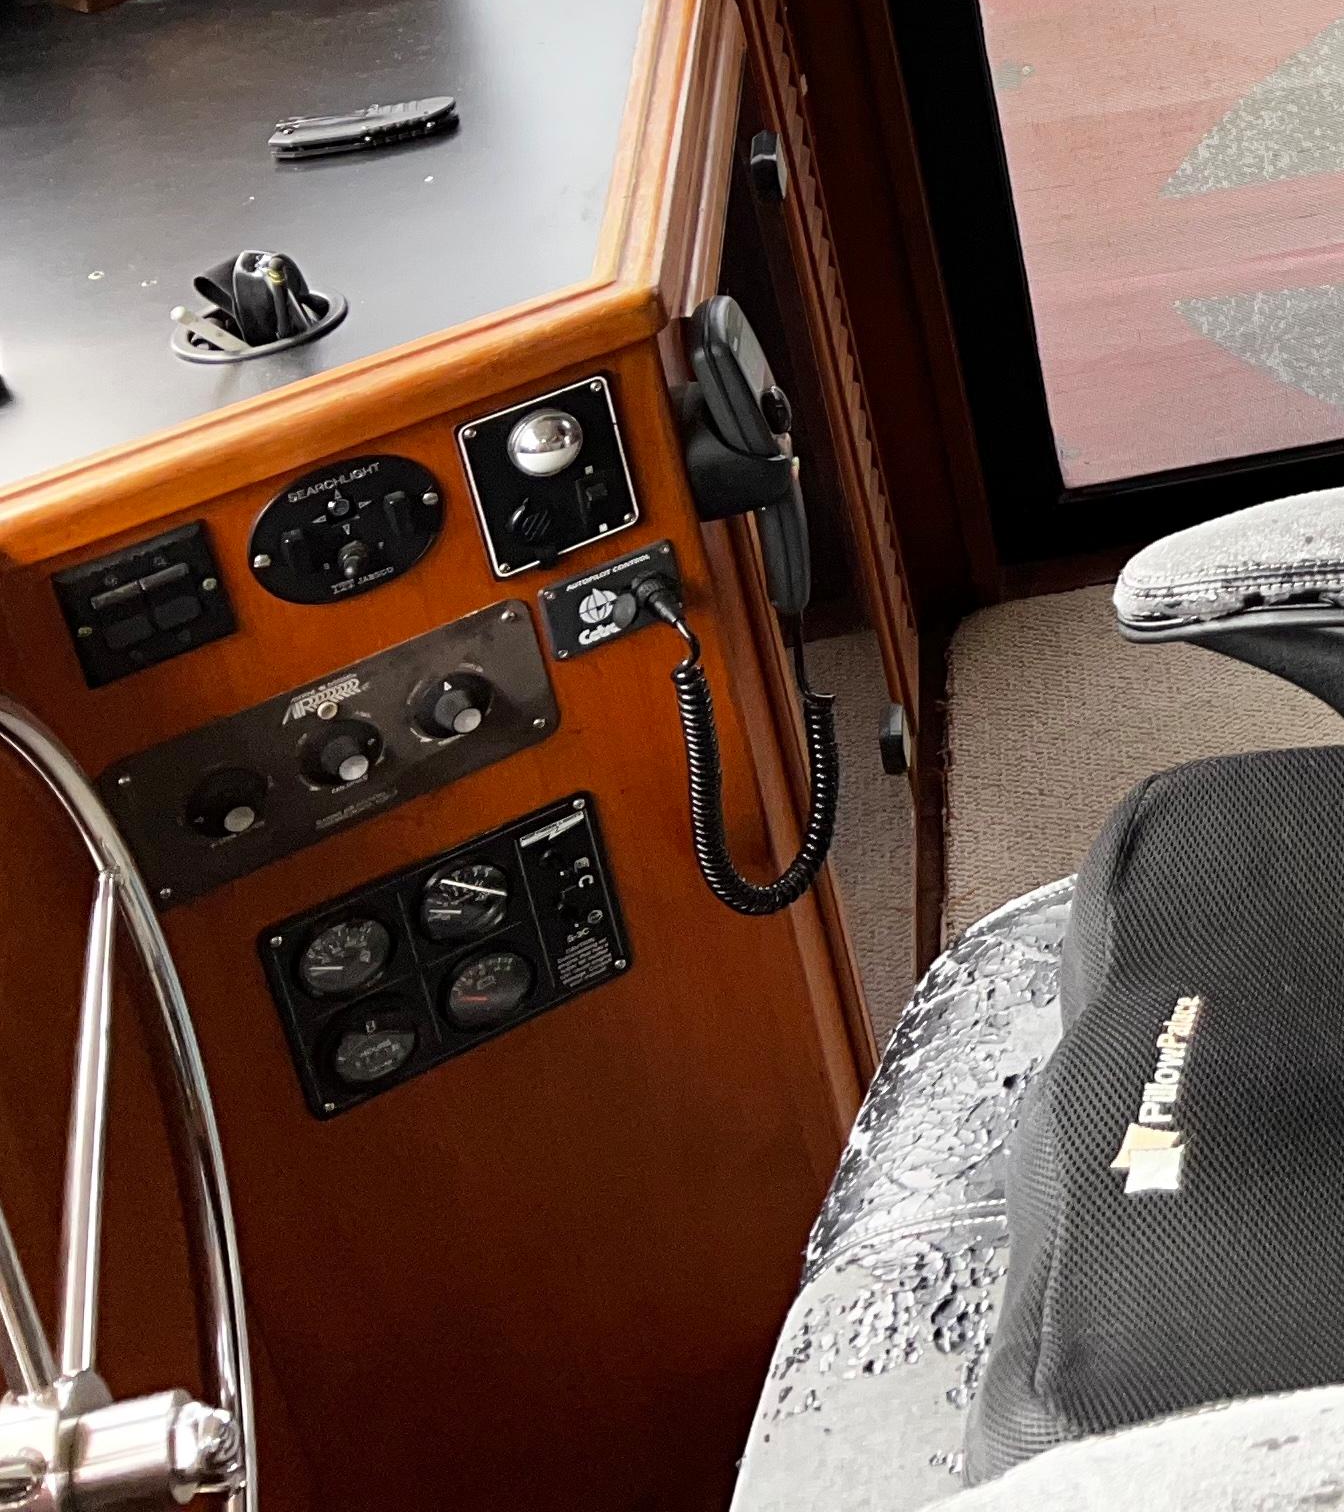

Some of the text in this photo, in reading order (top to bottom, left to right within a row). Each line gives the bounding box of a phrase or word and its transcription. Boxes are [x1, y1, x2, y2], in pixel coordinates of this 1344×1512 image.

[287, 462, 380, 504] SEARCHLIGHT
[357, 565, 395, 585] JABSCO
[565, 553, 651, 591] AUTOPILOT CONTROL
[1138, 995, 1200, 1123] PillowPalace
